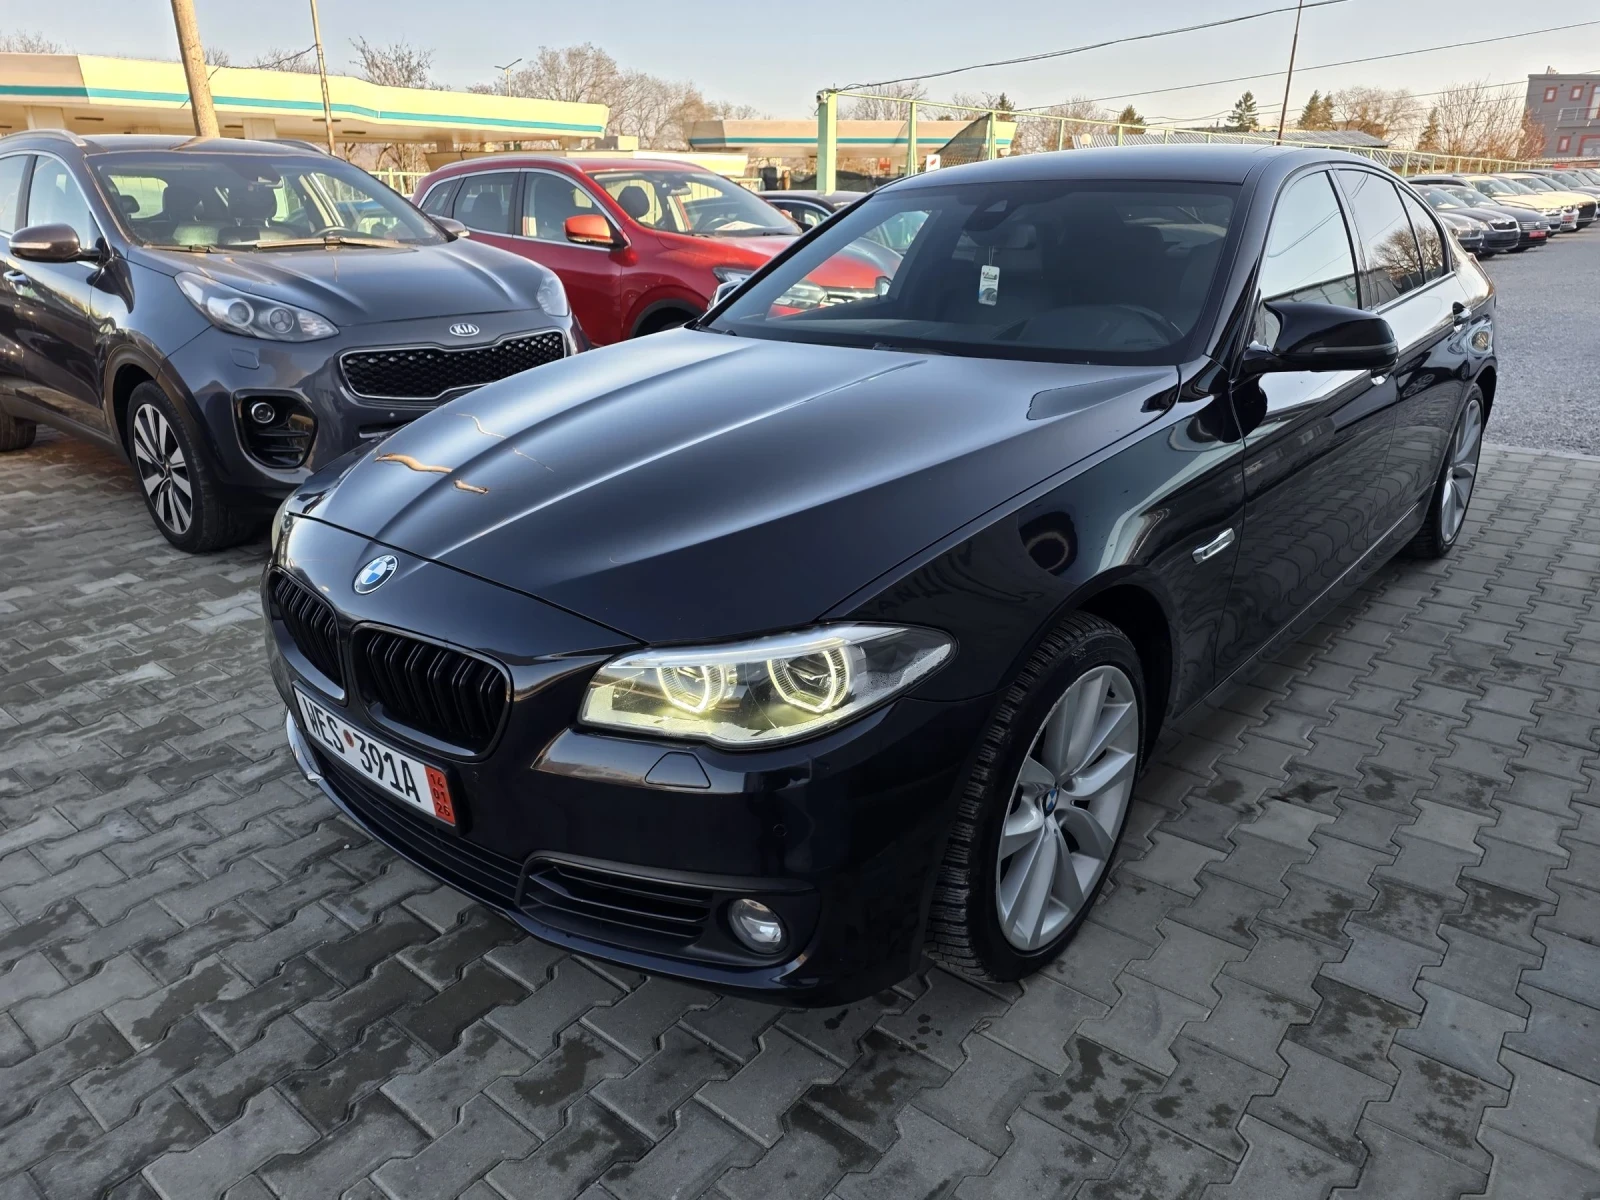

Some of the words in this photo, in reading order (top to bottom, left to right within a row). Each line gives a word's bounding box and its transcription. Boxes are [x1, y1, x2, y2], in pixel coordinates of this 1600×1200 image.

[453, 324, 477, 334] KIA
[302, 696, 345, 754] WES
[353, 732, 421, 803] 391A
[432, 787, 447, 805] 01
[436, 802, 451, 817] 26
